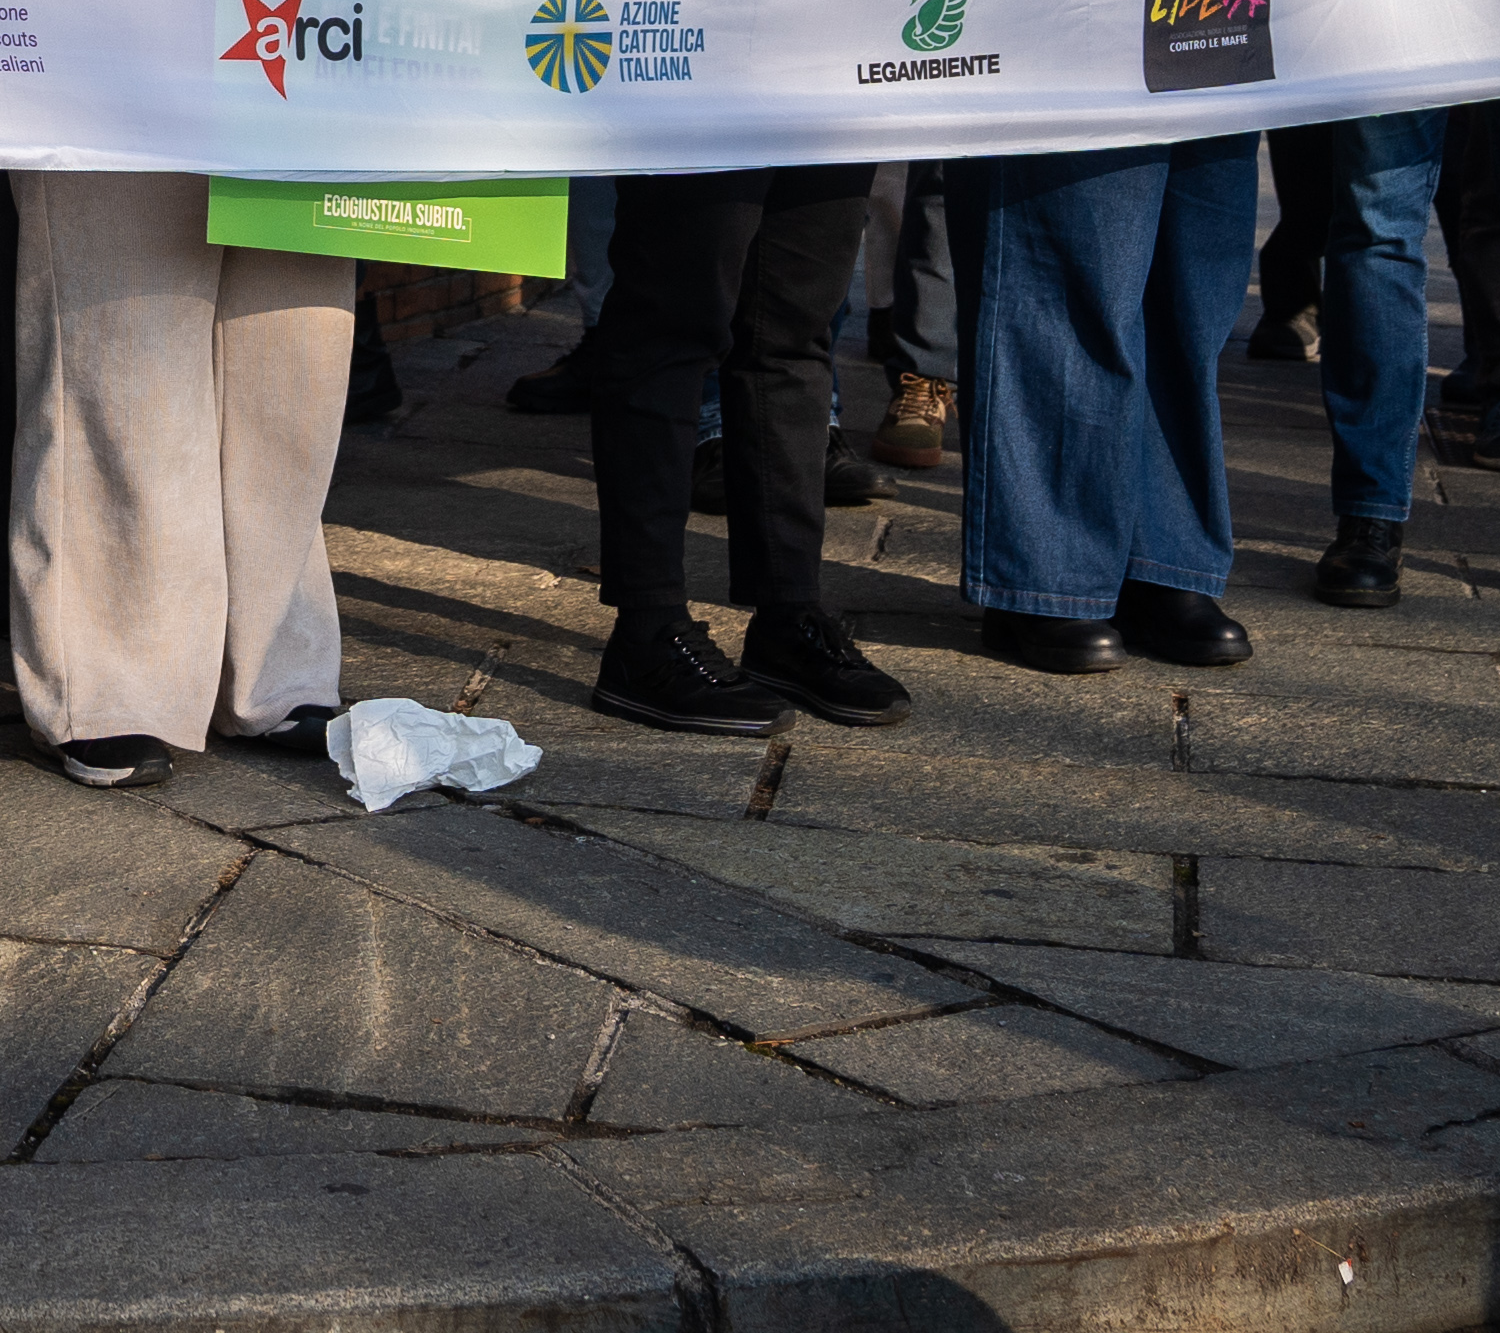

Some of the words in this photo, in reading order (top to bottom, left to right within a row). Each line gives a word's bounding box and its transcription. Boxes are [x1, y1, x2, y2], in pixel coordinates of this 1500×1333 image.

[620, 1, 681, 26] AZIONE
[255, 3, 364, 62] arci
[619, 28, 705, 54] CATTOLICA
[1170, 39, 1206, 52] CONTRO
[1209, 38, 1219, 48] LE
[1221, 34, 1248, 46] MAFIE
[619, 56, 692, 82] ITALIANA
[857, 54, 1000, 84] LEGAMBIENTE
[324, 194, 412, 224] ECOGIUSTIZIA
[416, 204, 466, 230] SUBITO.
